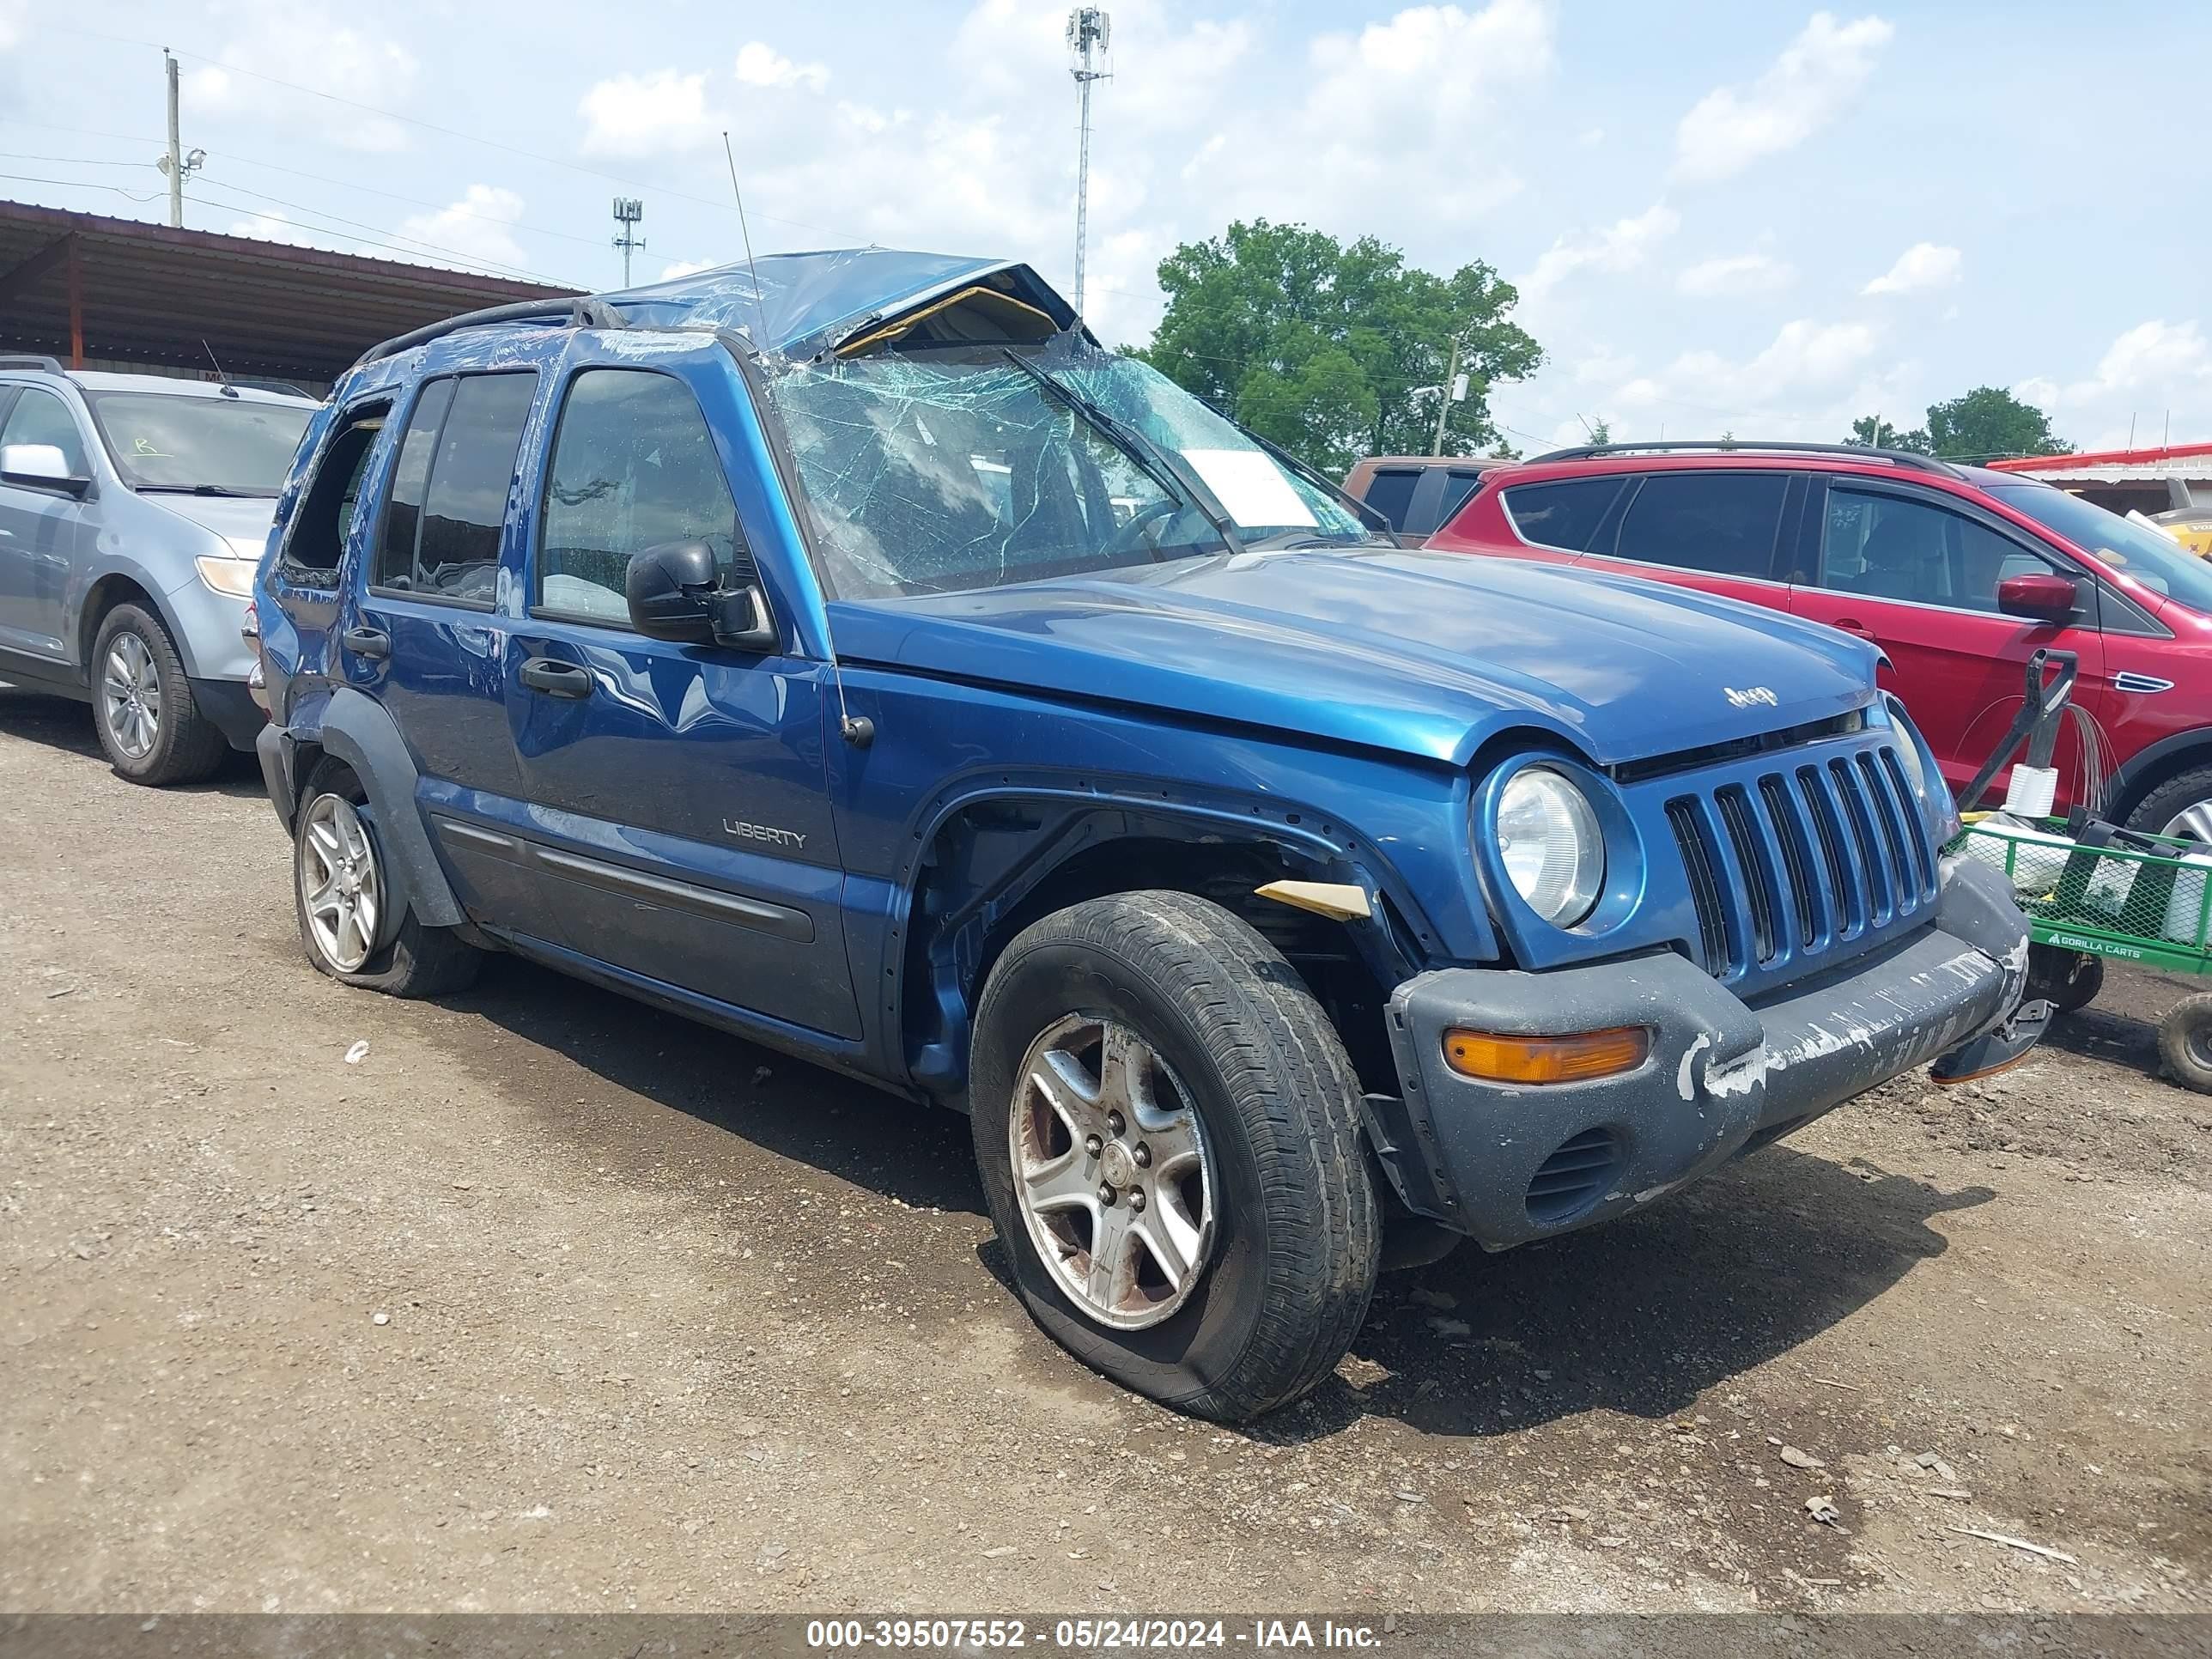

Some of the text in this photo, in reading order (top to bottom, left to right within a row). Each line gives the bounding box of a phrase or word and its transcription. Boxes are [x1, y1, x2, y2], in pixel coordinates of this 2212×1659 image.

[1723, 686, 1778, 709] Jeep
[722, 818, 807, 849] LIBERTY
[2061, 937, 2141, 959] GORILLA CARTS
